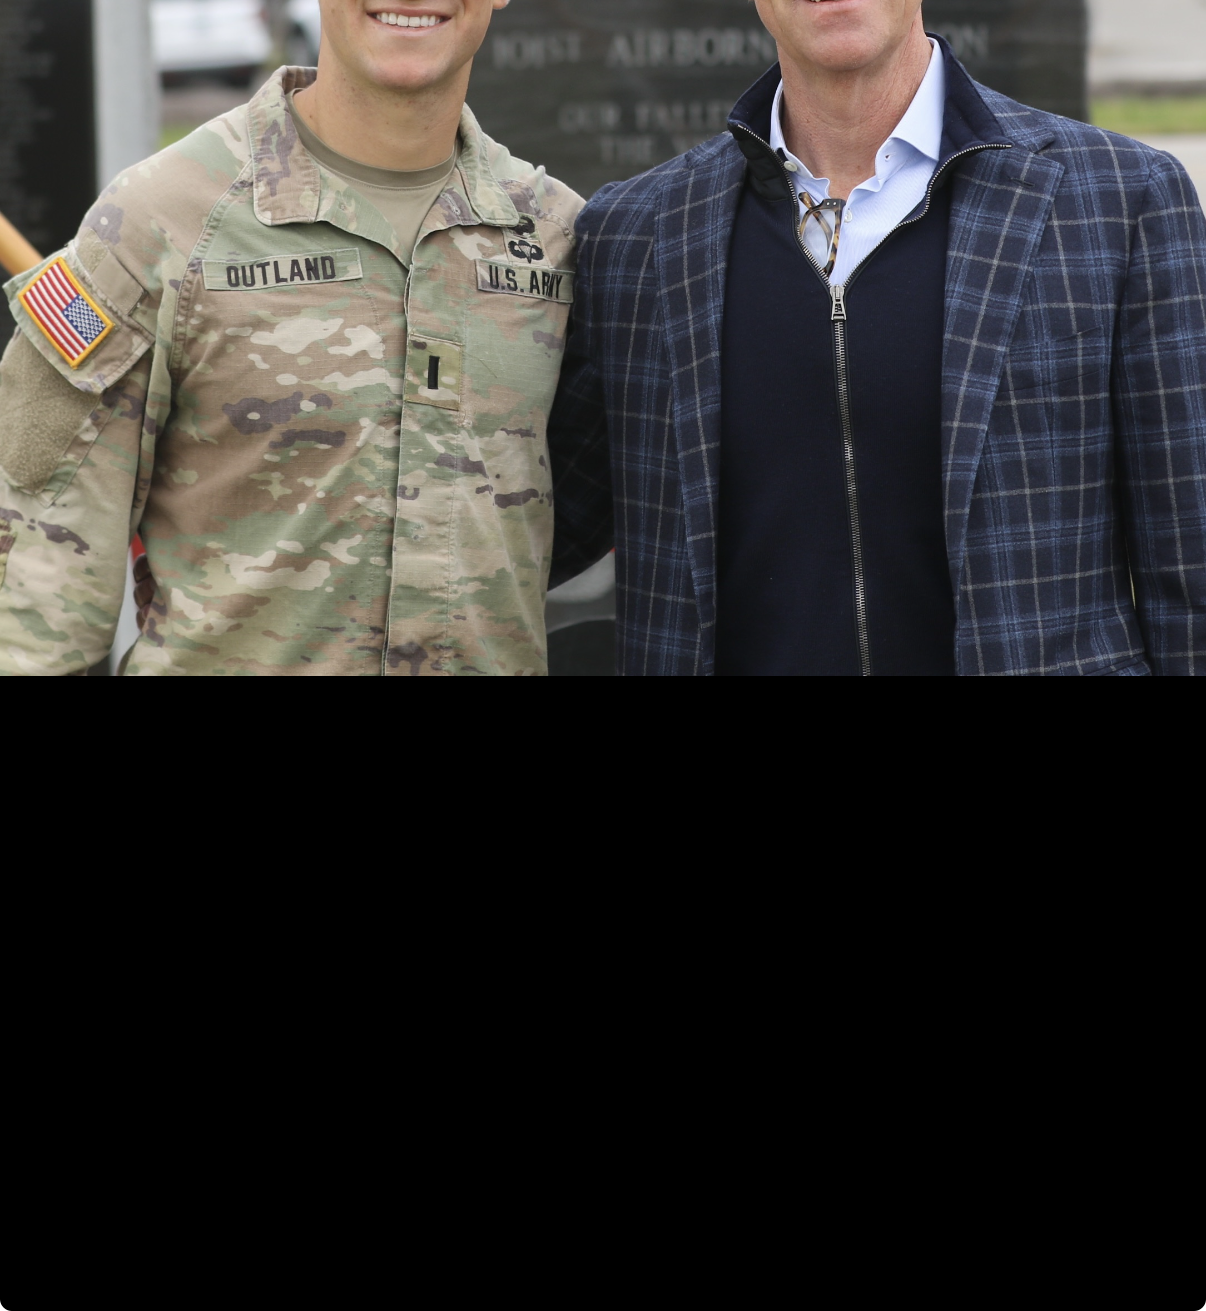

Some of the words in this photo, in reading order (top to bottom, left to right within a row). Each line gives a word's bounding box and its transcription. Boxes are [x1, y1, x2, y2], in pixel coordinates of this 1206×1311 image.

[491, 30, 582, 70] 101ST
[605, 27, 778, 68] AIRBORN
[226, 256, 336, 288] OUTLAND
[489, 265, 525, 293] U.S.
[529, 270, 563, 299] ARMY
